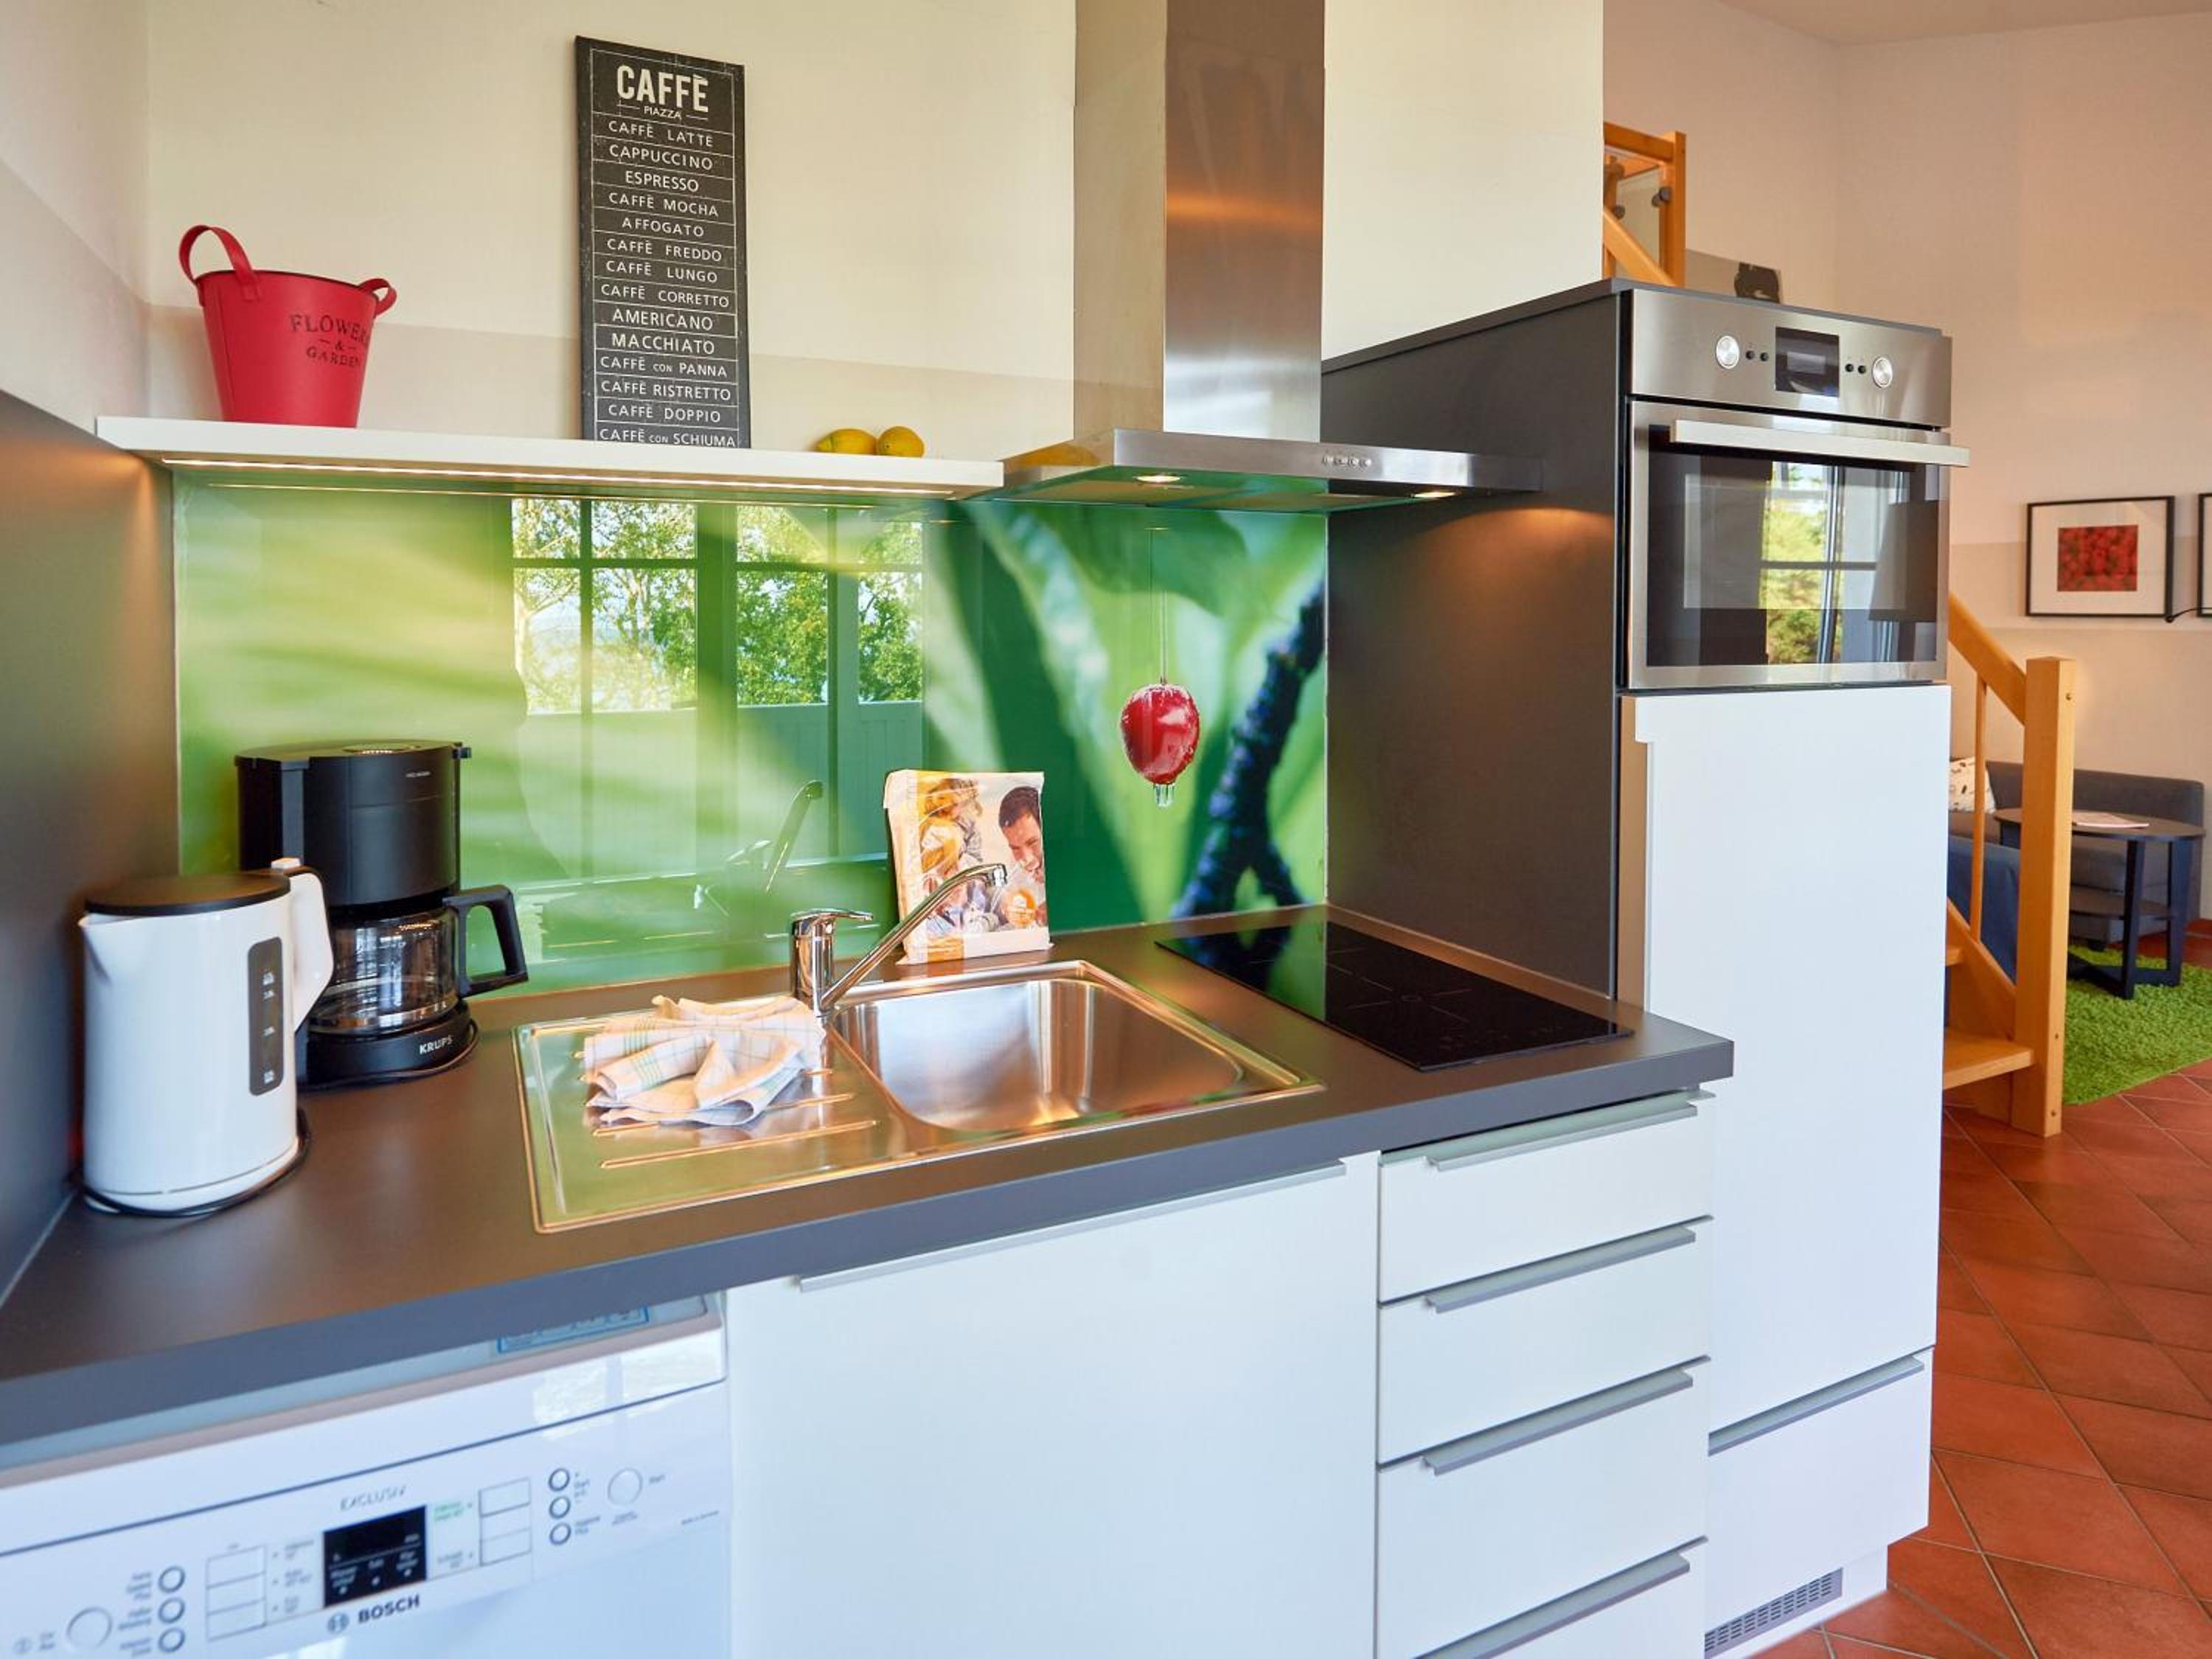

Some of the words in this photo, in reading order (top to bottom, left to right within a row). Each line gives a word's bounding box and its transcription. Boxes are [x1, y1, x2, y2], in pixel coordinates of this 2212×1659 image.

[644, 105, 682, 119] PIAZZA
[667, 130, 713, 147] LATTE
[609, 145, 713, 170] CAPPUCCINO
[625, 170, 699, 192] ESPRESSO
[664, 199, 719, 217] MOCHA
[622, 218, 704, 237] AFFOGATO
[665, 245, 722, 262] FREDDO
[667, 267, 717, 283] LUNGO
[658, 290, 729, 307] CORRETTO
[612, 308, 713, 330] AMERICANO
[335, 341, 344, 351] &
[612, 333, 714, 355] MACCHIATO
[679, 362, 727, 378] PANNA
[653, 384, 731, 400] RISTRETTO
[664, 408, 720, 422] DOPPIO
[673, 433, 735, 447] SCHIUMA
[420, 1034, 453, 1054] KRUPS
[358, 1594, 420, 1624] BOSCH
